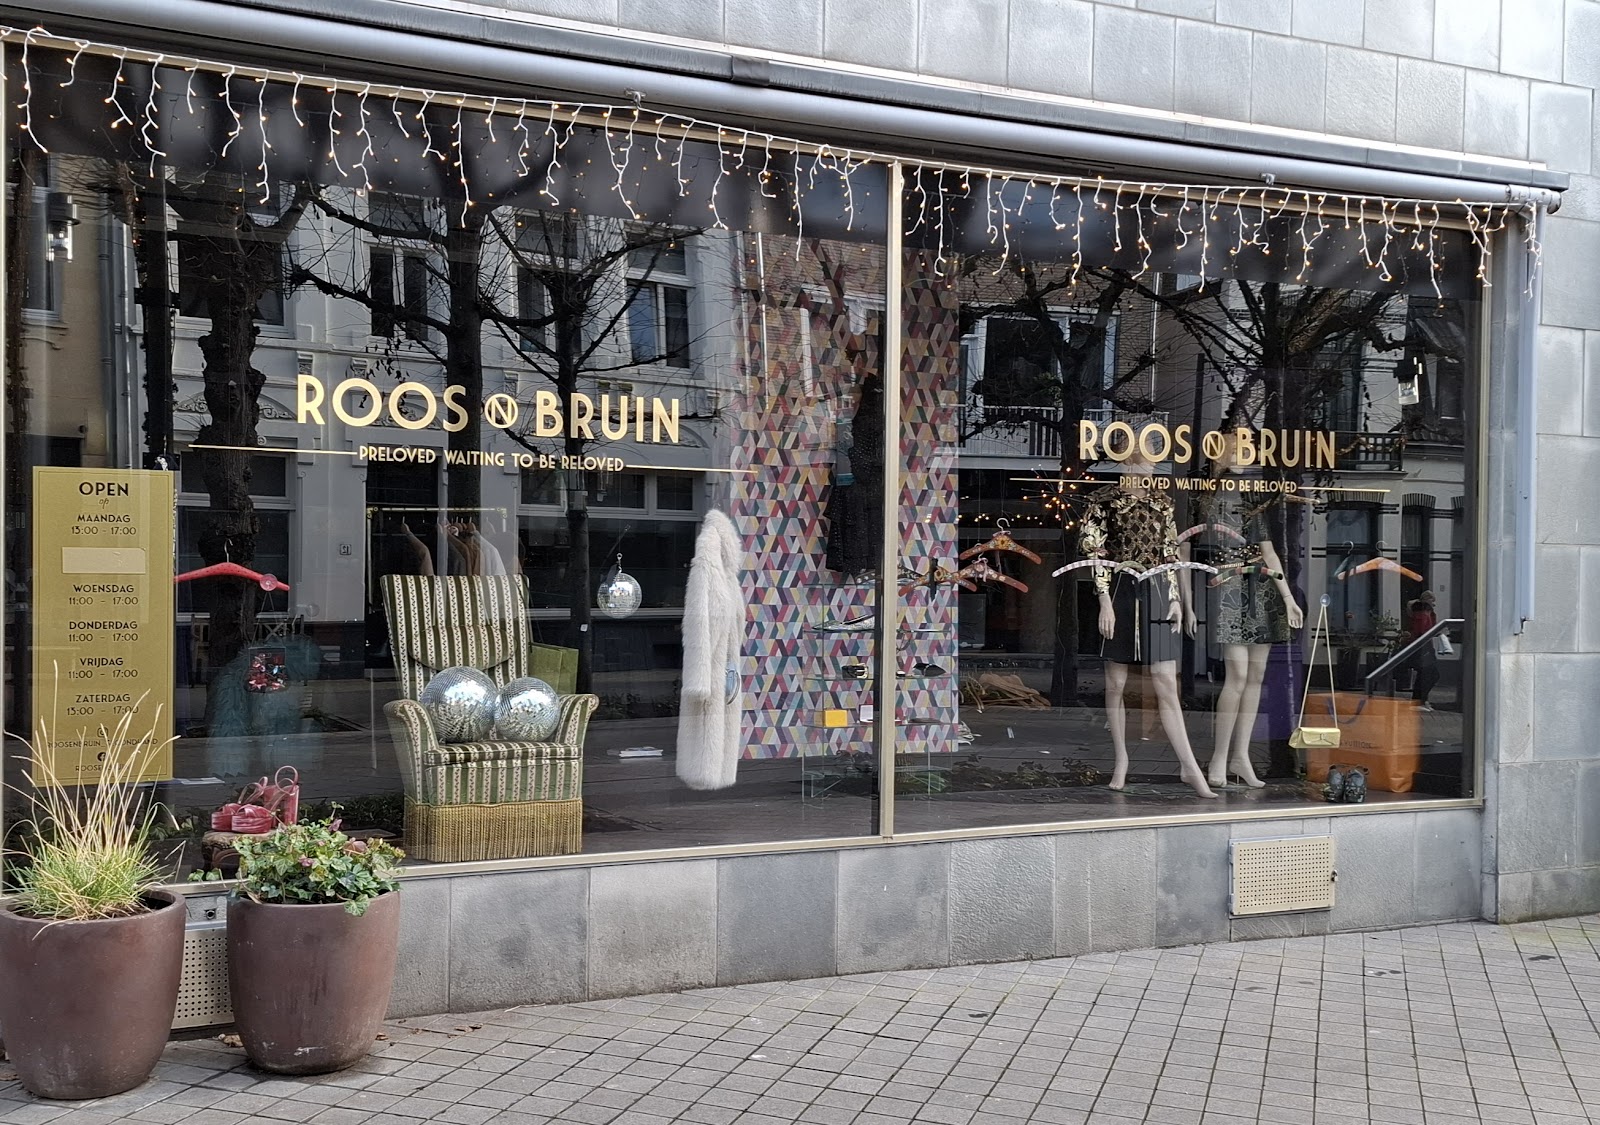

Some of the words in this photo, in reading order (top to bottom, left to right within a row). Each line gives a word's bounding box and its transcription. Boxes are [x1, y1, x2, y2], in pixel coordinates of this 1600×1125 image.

[297, 374, 469, 432] ROOS
[536, 390, 679, 444] BRUIN
[1079, 419, 1191, 464] ROOS
[1236, 427, 1335, 469] BRUIN
[359, 445, 436, 464] PRELOVED
[443, 449, 505, 467] WAITING
[511, 453, 534, 468] TO
[539, 454, 556, 470] BE
[561, 455, 625, 472] RELOVED
[78, 481, 129, 497] OPEN
[1119, 475, 1170, 490] PRELOVED
[1175, 477, 1216, 491] WAITING
[1220, 478, 1236, 492] TO
[1239, 479, 1251, 492] BE
[1254, 479, 1297, 494] RELOVED
[77, 514, 131, 523] MAANDAG
[71, 526, 98, 535] 13:00
[110, 526, 137, 535] 17:00
[73, 584, 134, 593] WOENSDAG
[69, 597, 93, 605] 11:00
[112, 597, 138, 605] 17:00
[69, 620, 138, 630] DONDERDAG
[68, 633, 93, 642] 11:00
[112, 633, 138, 642] 17:00
[80, 657, 124, 667] VRIJDAG
[68, 670, 93, 679] 11:00
[112, 669, 138, 678] 17:00
[75, 693, 131, 703] ZATERDAG
[66, 706, 94, 716] 13:00
[113, 705, 139, 715] 17:00
